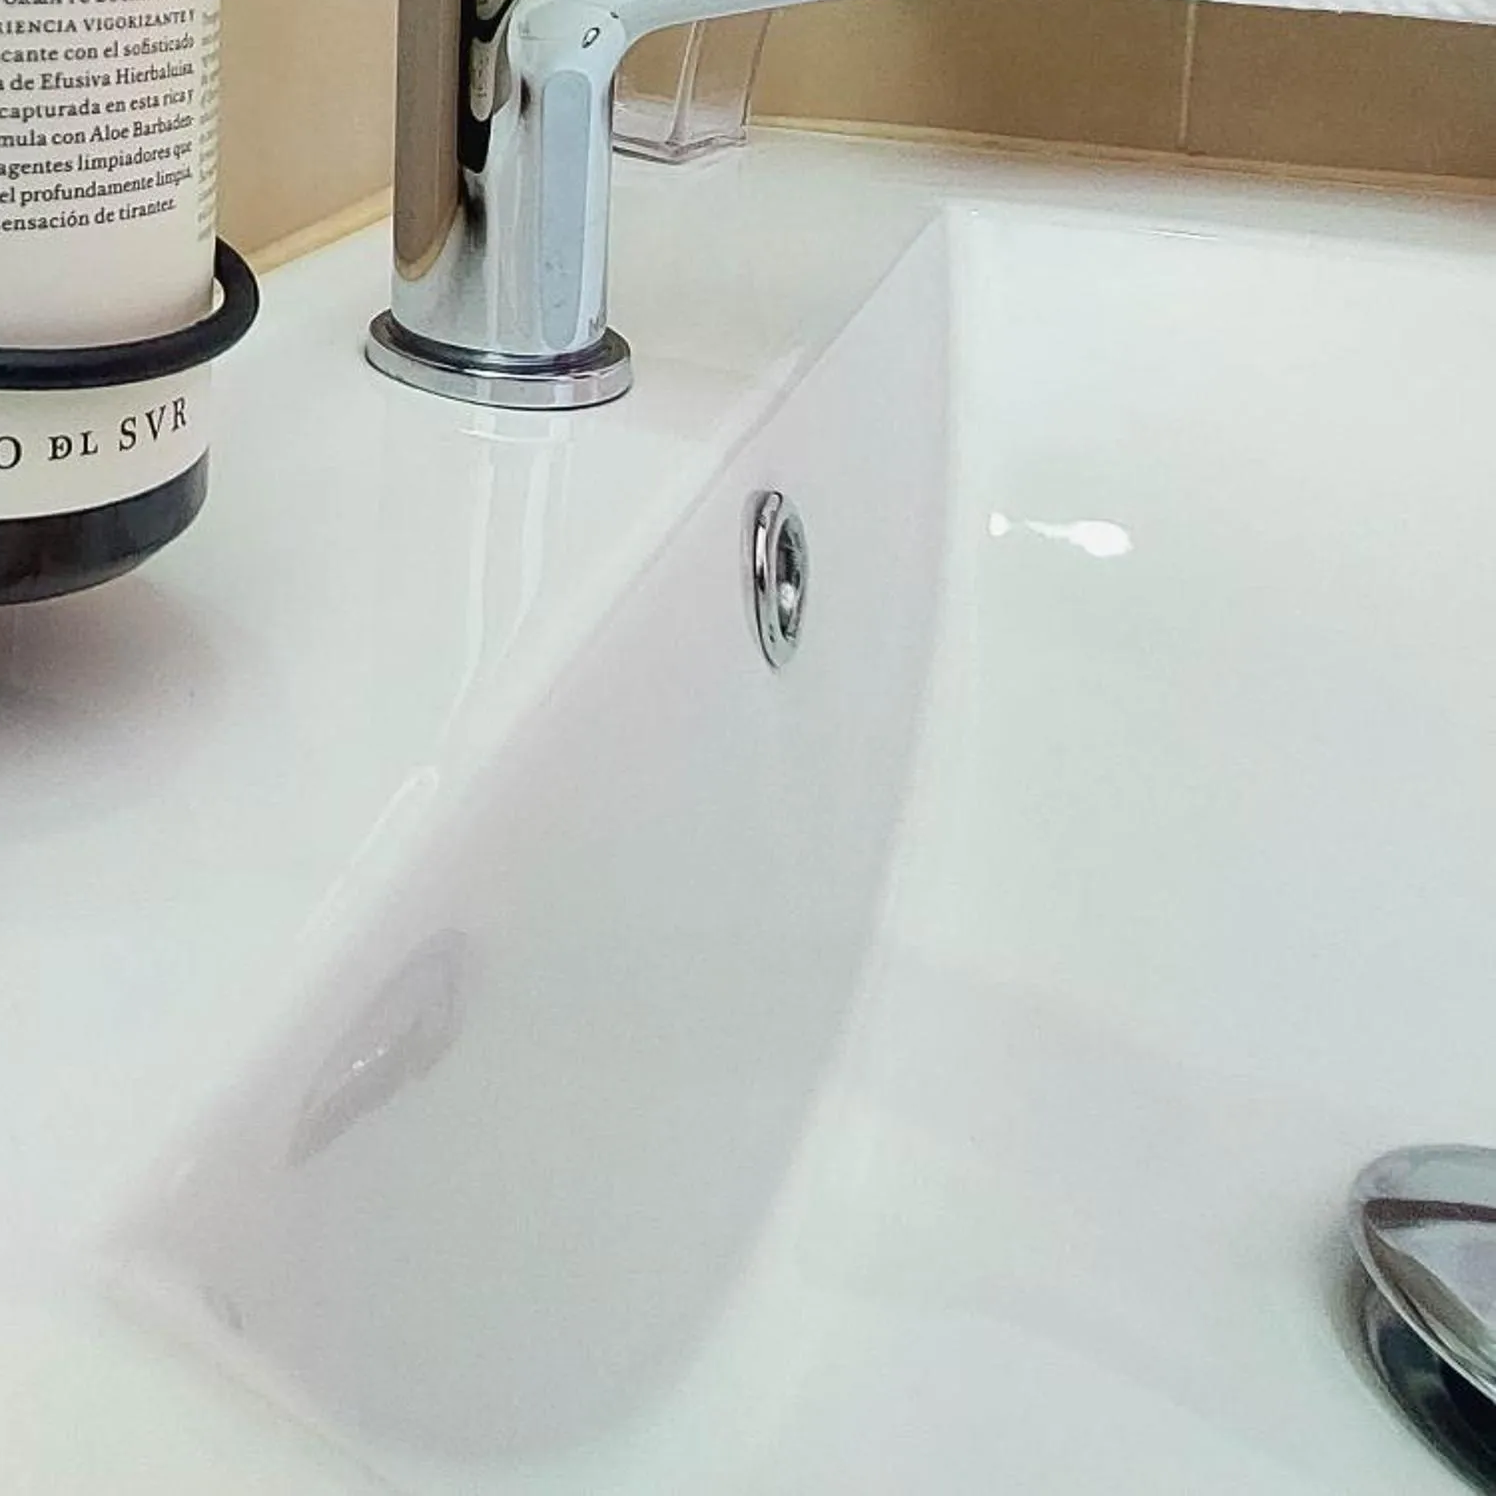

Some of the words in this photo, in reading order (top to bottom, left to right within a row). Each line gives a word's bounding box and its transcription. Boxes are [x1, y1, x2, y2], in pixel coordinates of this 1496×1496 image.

[84, 10, 186, 31] VIGORIZANTE
[64, 46, 99, 61] con
[104, 40, 118, 58] el
[123, 32, 195, 57] sofisticado
[10, 74, 35, 91] de
[40, 71, 111, 91] Efusiva
[115, 62, 195, 85] Hierbaluisa
[105, 100, 126, 112] en
[130, 94, 160, 111] esta
[163, 88, 186, 104] rica
[186, 89, 194, 104] y
[51, 130, 86, 145] con
[89, 124, 130, 143] Aloe
[77, 146, 171, 173] limpiadores
[172, 140, 193, 160] que
[20, 176, 154, 207] profundamente
[94, 206, 115, 225] de
[118, 397, 187, 452] SVR
